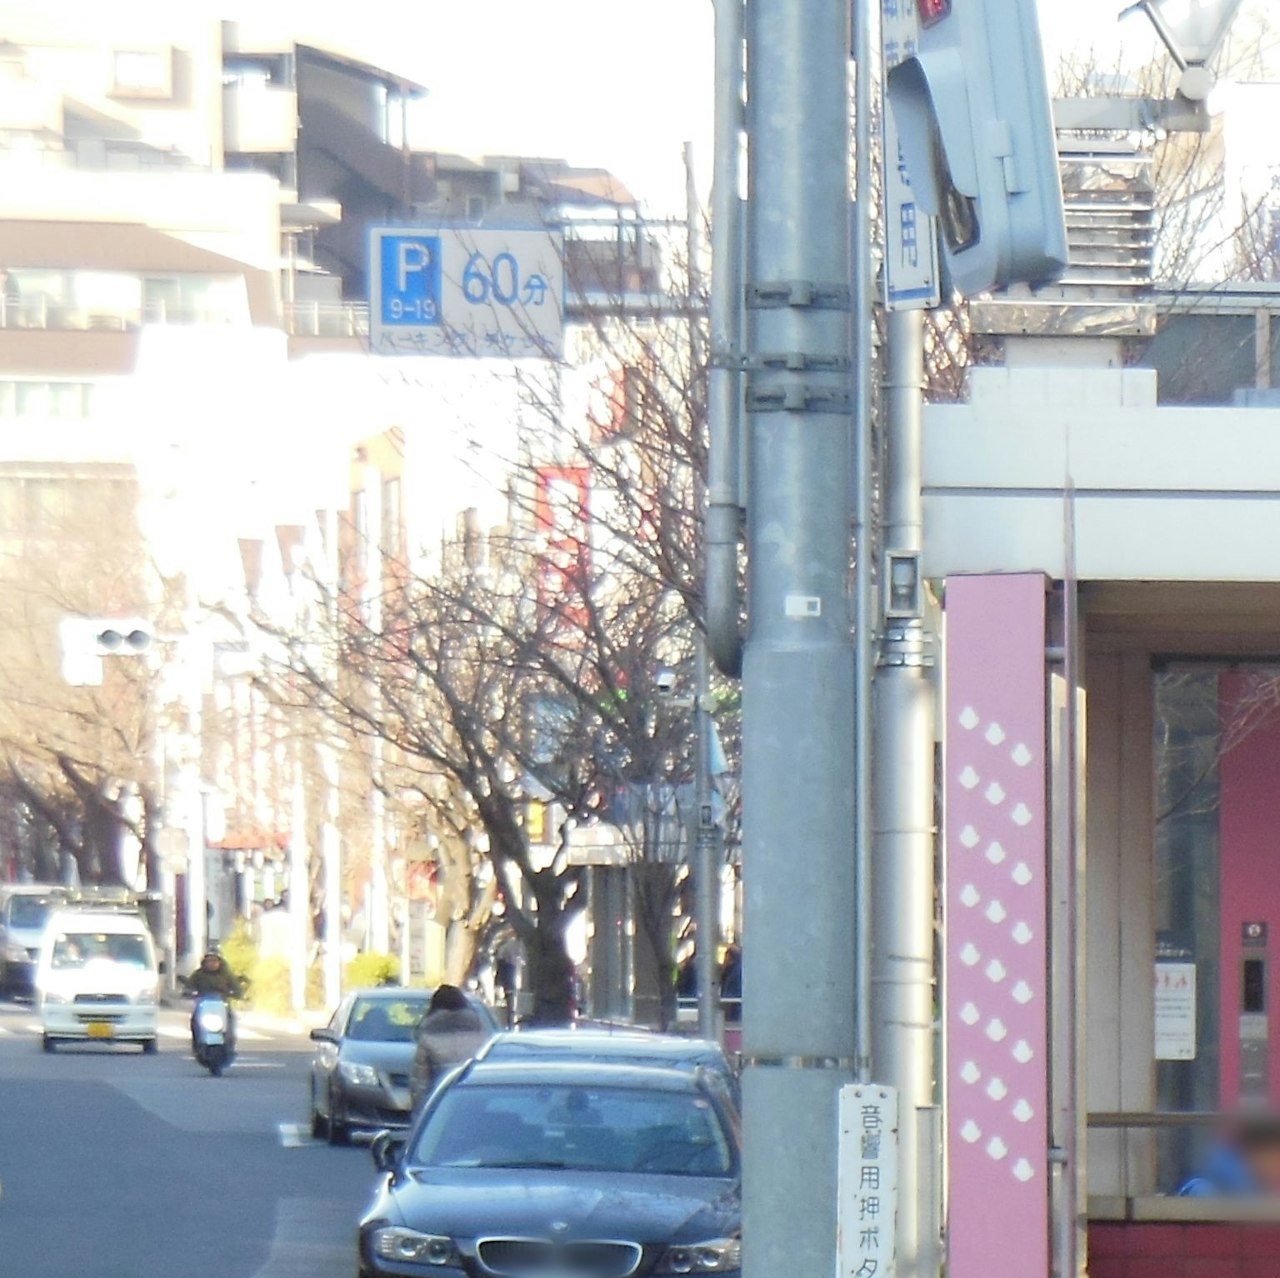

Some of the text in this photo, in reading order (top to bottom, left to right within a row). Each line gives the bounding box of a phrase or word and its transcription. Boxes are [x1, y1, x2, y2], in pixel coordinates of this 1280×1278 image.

[397, 242, 431, 292] P
[462, 252, 548, 306] 60分
[390, 299, 437, 320] 9-19
